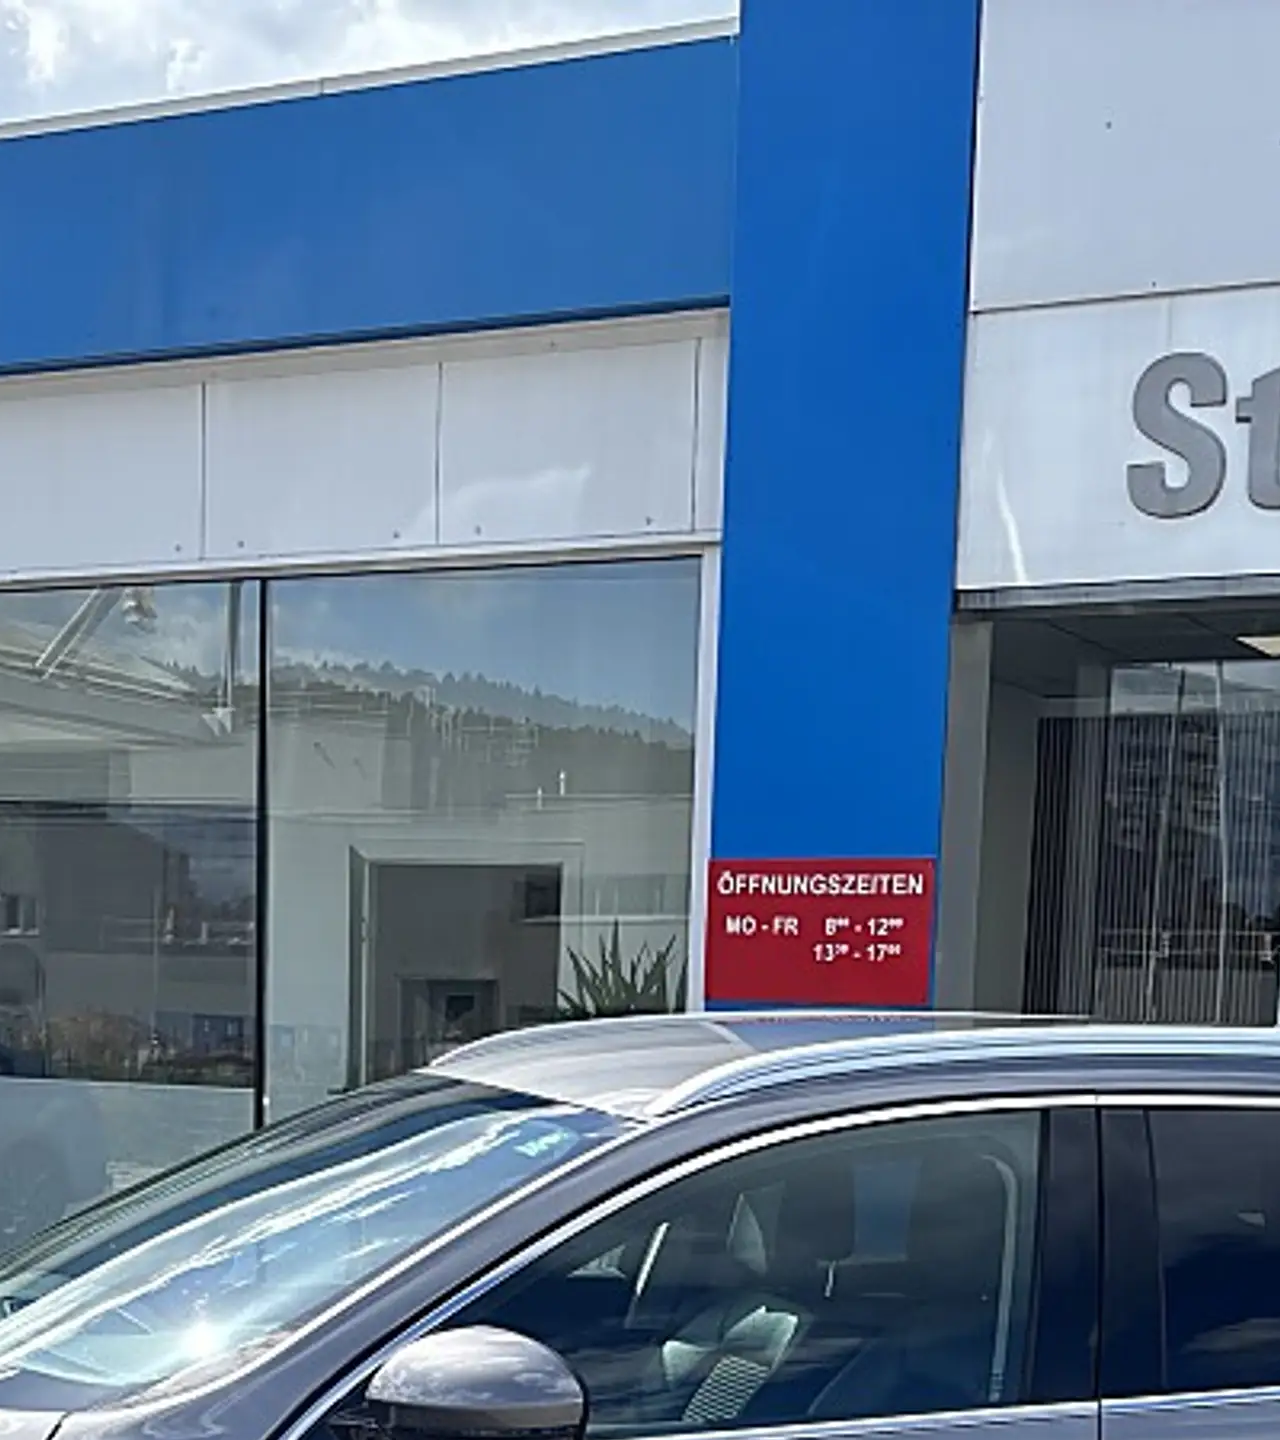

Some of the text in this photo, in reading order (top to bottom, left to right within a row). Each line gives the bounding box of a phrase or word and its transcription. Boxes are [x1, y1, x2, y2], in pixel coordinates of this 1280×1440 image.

[717, 869, 924, 896] ÖFFNUNGSZEITEN
[725, 914, 757, 936] MO
[772, 915, 799, 936] FR
